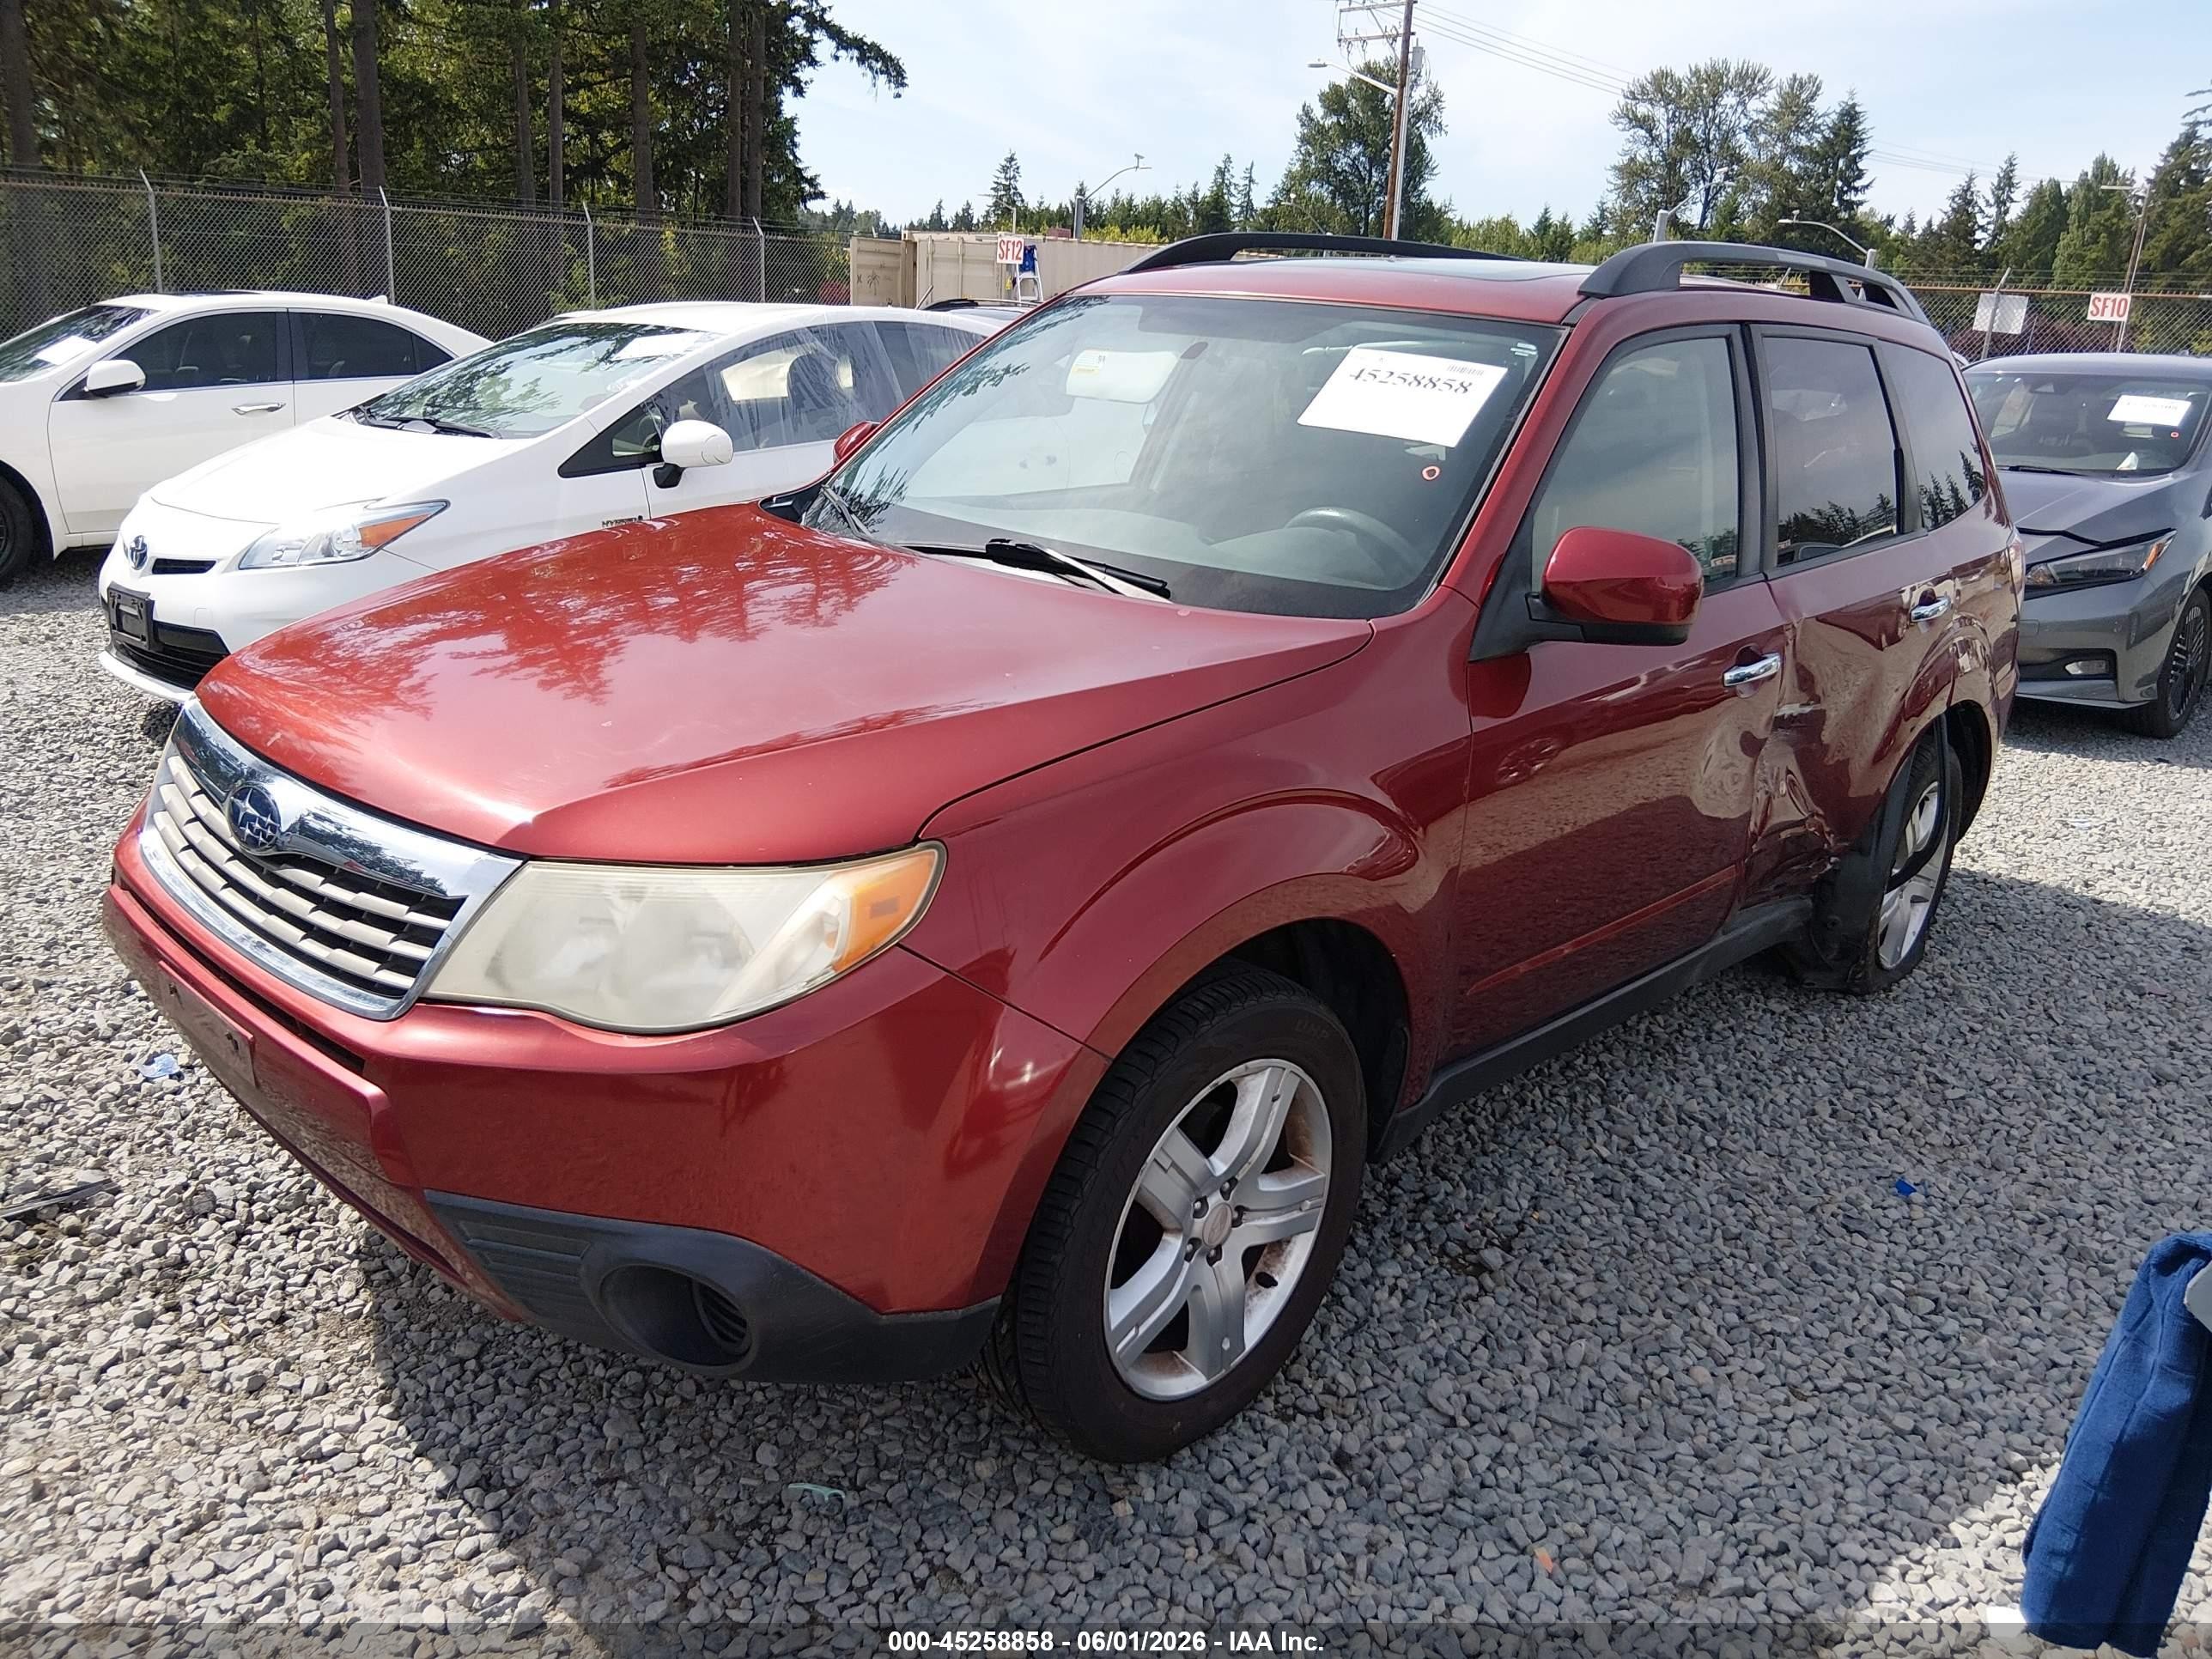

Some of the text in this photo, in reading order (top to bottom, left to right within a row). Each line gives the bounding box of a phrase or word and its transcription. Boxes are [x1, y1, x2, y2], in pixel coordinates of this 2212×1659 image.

[998, 240, 1023, 260] SF12
[2089, 296, 2129, 318] SF10
[1349, 367, 1474, 395] 45258858
